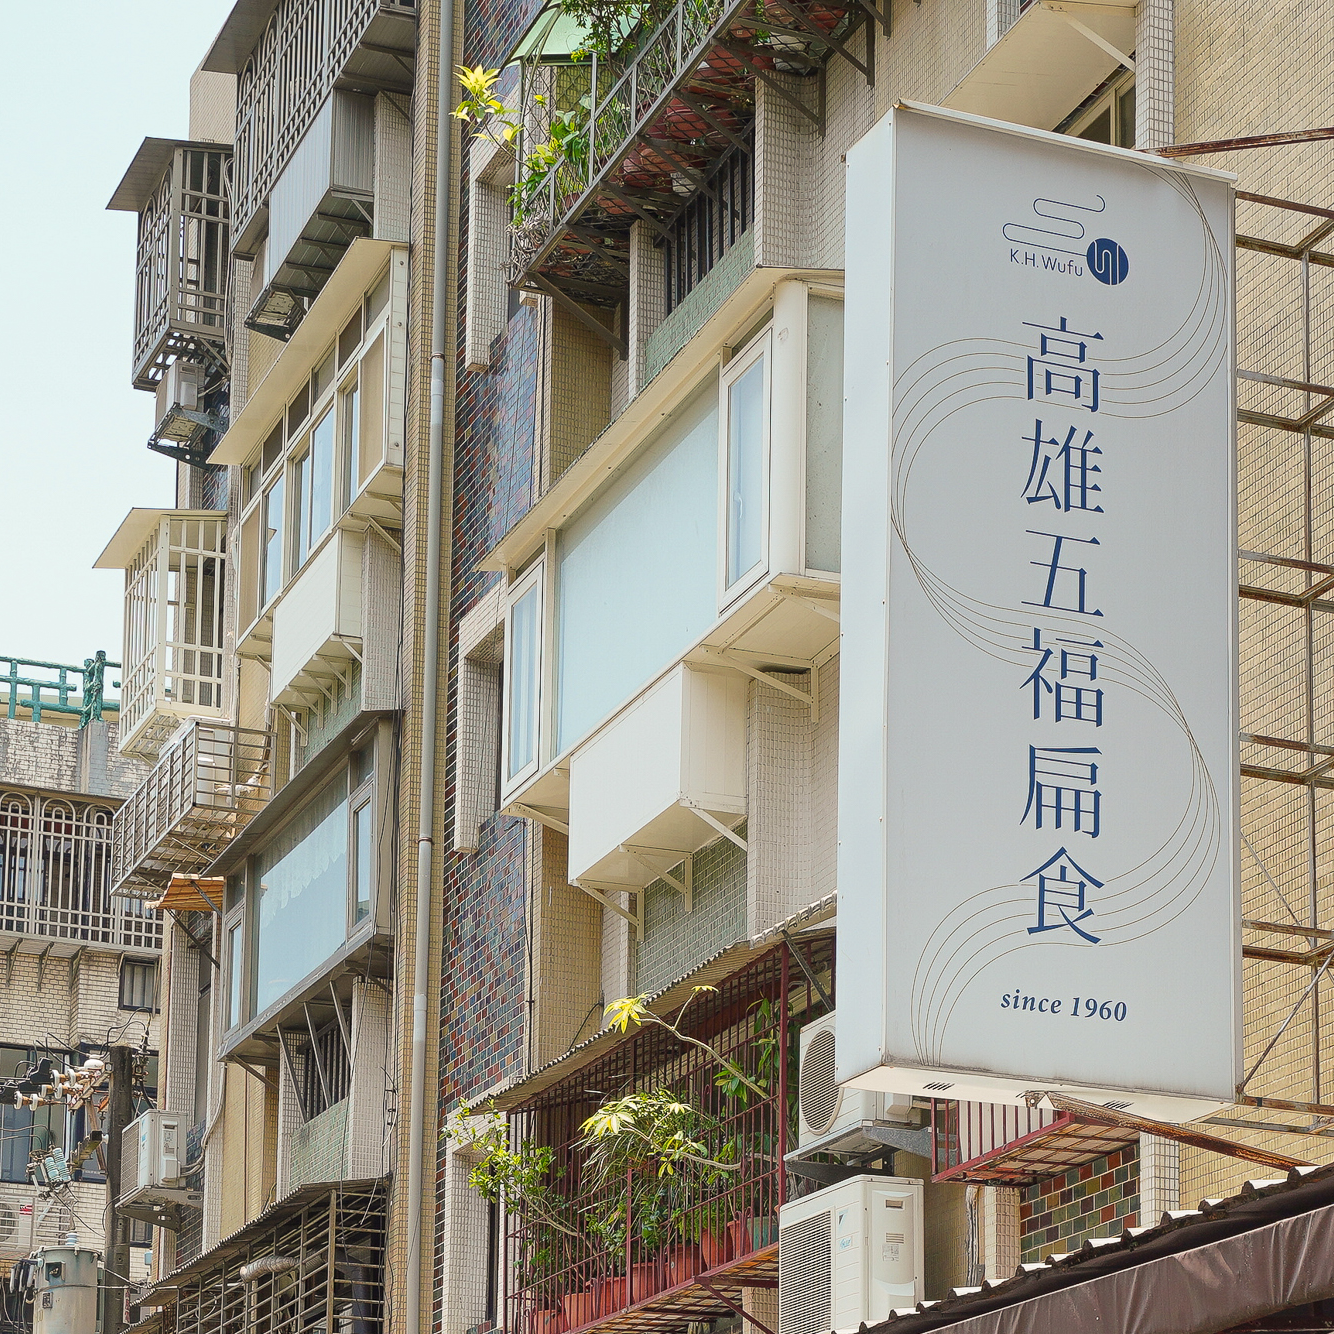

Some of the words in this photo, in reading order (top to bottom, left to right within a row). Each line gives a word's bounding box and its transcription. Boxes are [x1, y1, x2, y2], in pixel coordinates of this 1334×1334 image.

[1010, 248, 1039, 268] K.H.
[1042, 254, 1083, 277] Wufu
[1018, 316, 1105, 946] 高雄五福扁食
[1000, 988, 1062, 1014] since
[1070, 996, 1128, 1022] 1960
